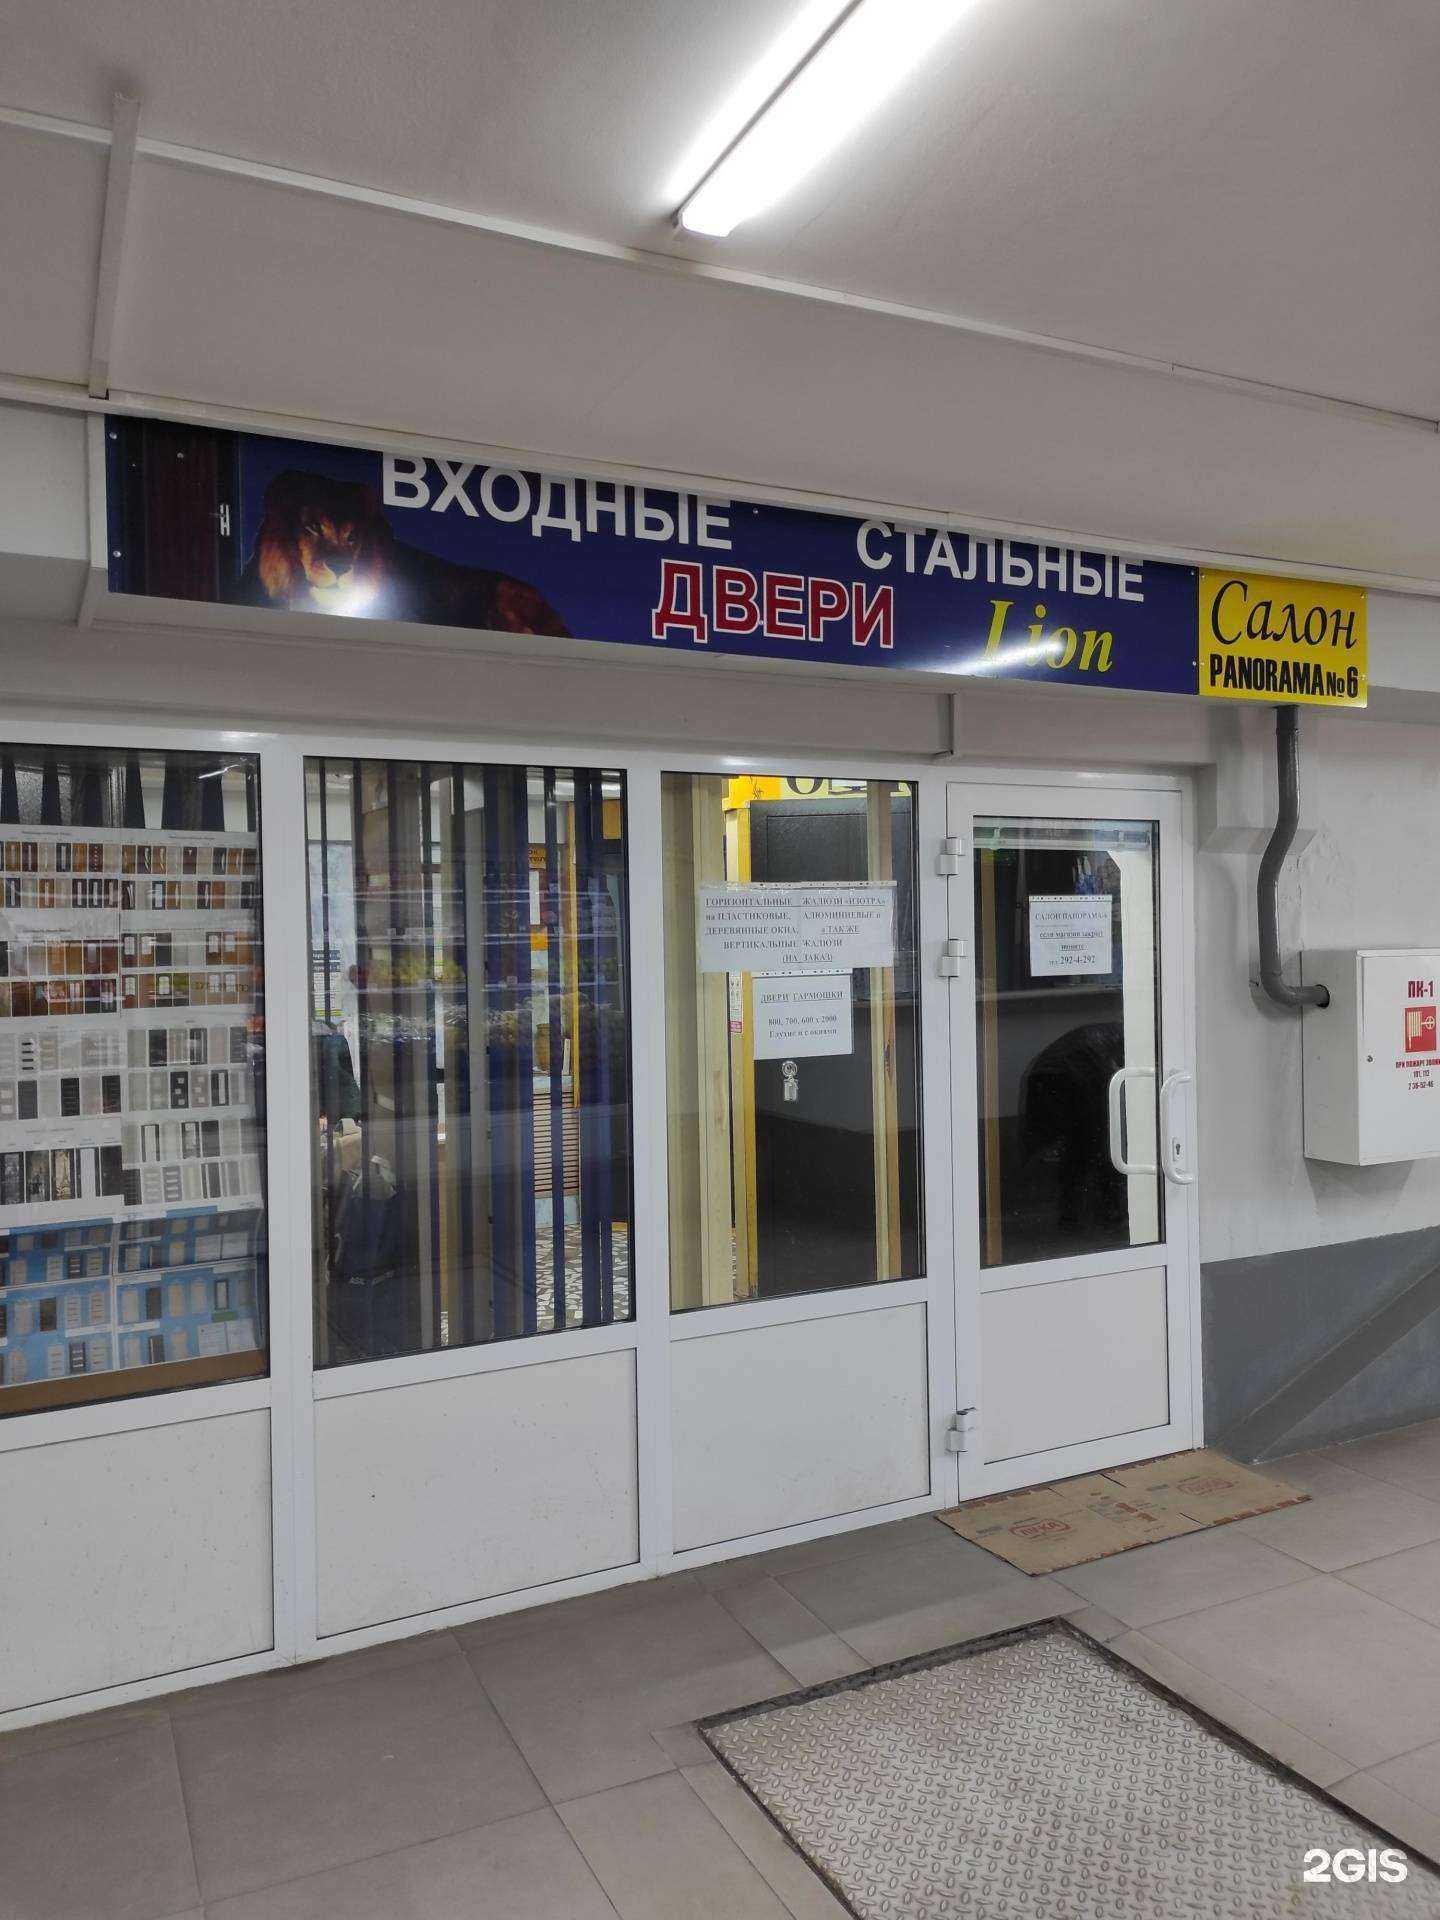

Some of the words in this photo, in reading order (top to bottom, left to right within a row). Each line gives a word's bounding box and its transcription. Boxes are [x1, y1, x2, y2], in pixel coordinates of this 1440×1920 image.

[382, 453, 733, 550] ВХОДНЫЕ
[855, 519, 1145, 603] СТАЛЬНЫЕ
[651, 558, 895, 649] ДВЕРИ
[980, 600, 1114, 673] Lion
[1211, 580, 1358, 650] Салон
[1209, 653, 1325, 697] PANORAMA
[802, 896, 844, 905] ЖАЛЮЗИ
[802, 938, 843, 948] ЖАЛЮЗИ
[1407, 980, 1434, 999] ПК-1
